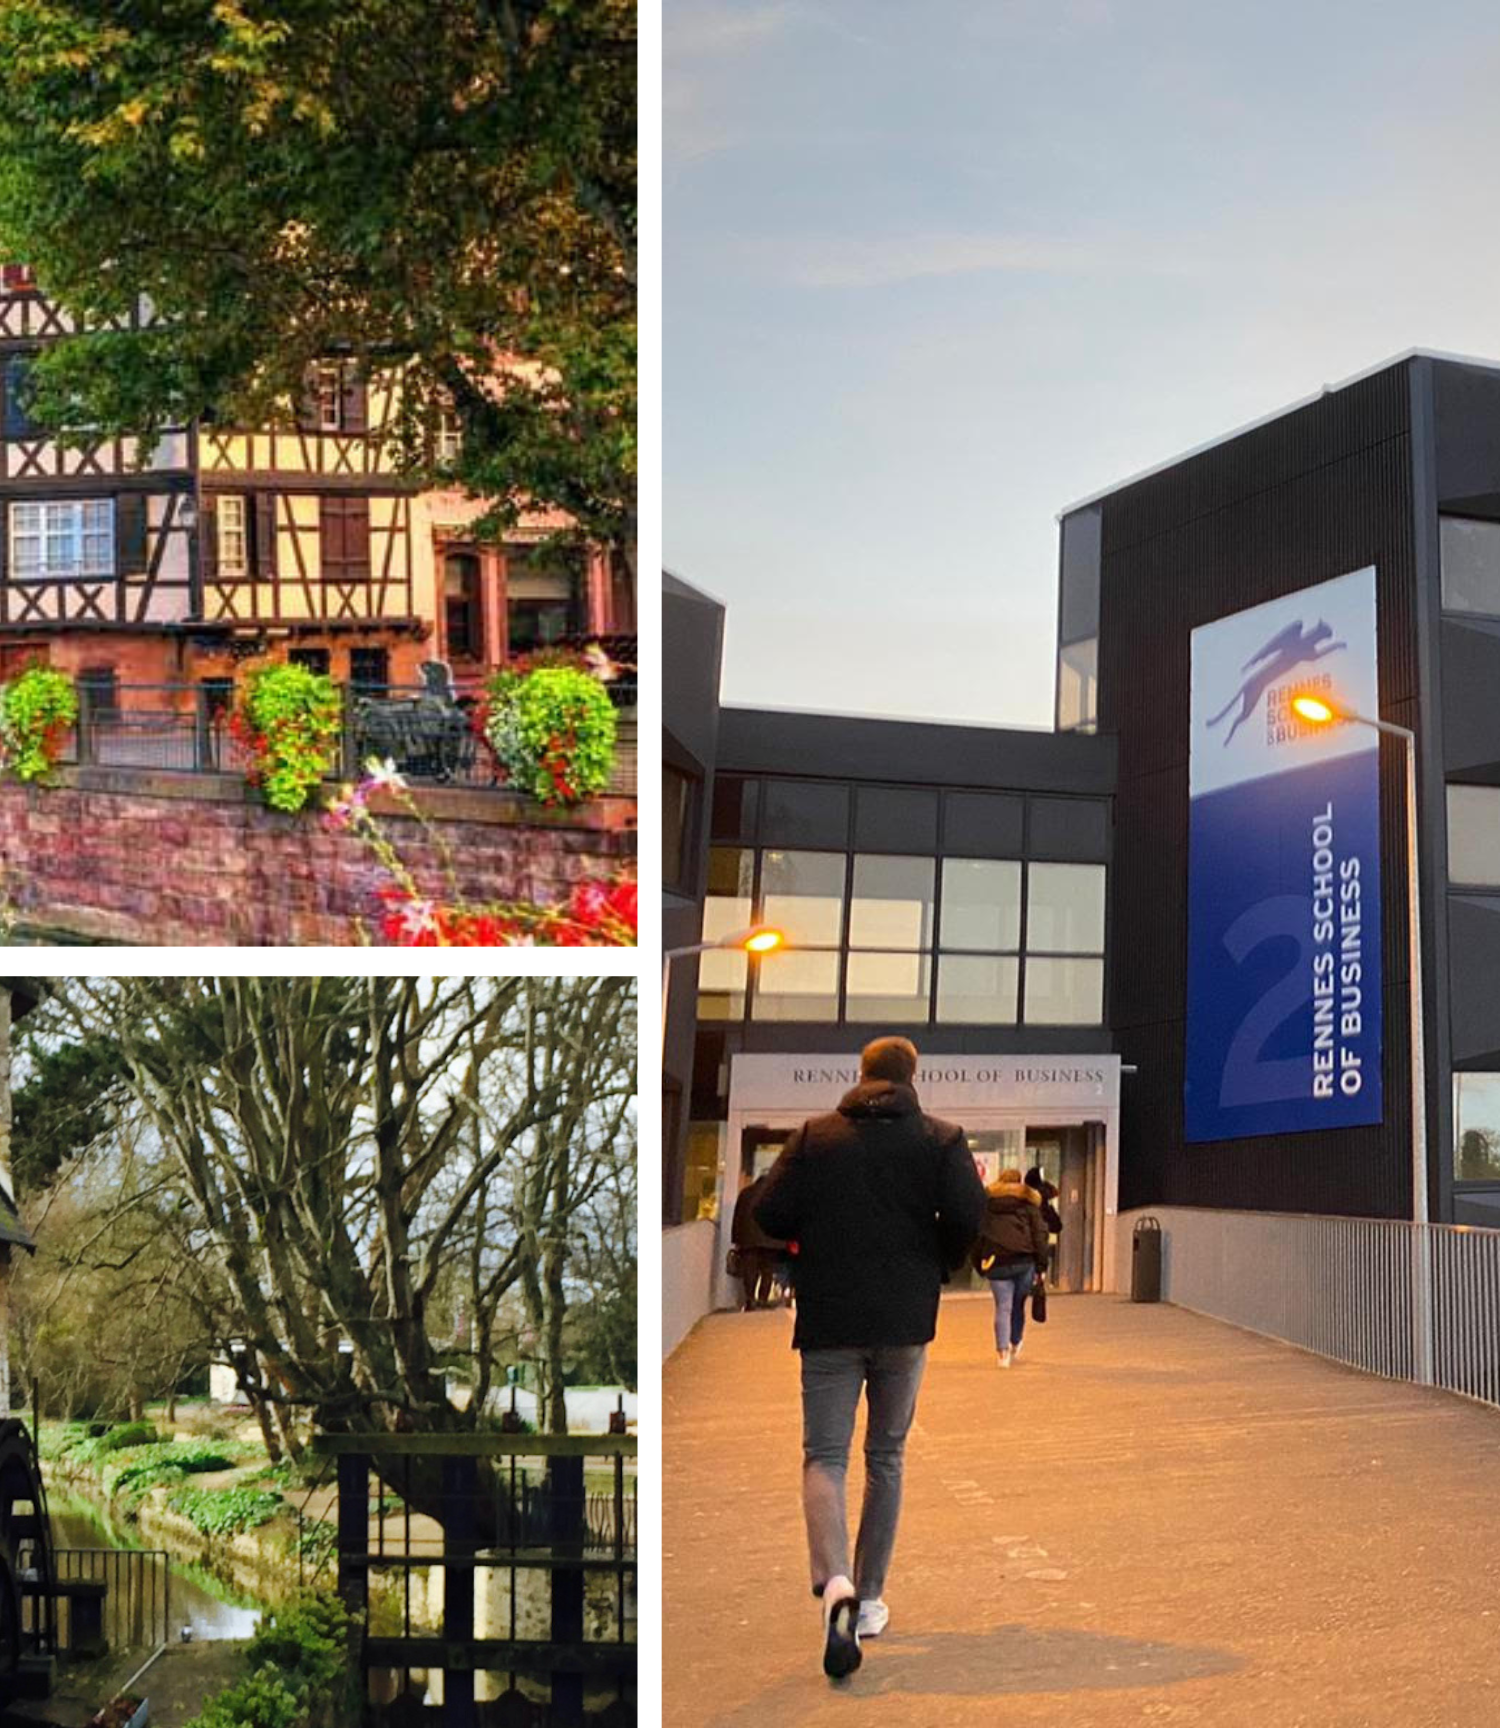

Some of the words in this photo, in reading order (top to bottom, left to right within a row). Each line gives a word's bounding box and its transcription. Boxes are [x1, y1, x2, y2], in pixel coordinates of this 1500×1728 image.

[1312, 801, 1335, 943] SCHOOL
[1218, 894, 1321, 1109] 2
[1340, 856, 1362, 1037] BUSINESS
[916, 1069, 972, 1083] HOOL
[976, 1069, 1002, 1083] OF
[1015, 1069, 1105, 1083] BUSINESS
[1313, 952, 1335, 1099] RENNES
[1340, 1047, 1362, 1096] OF
